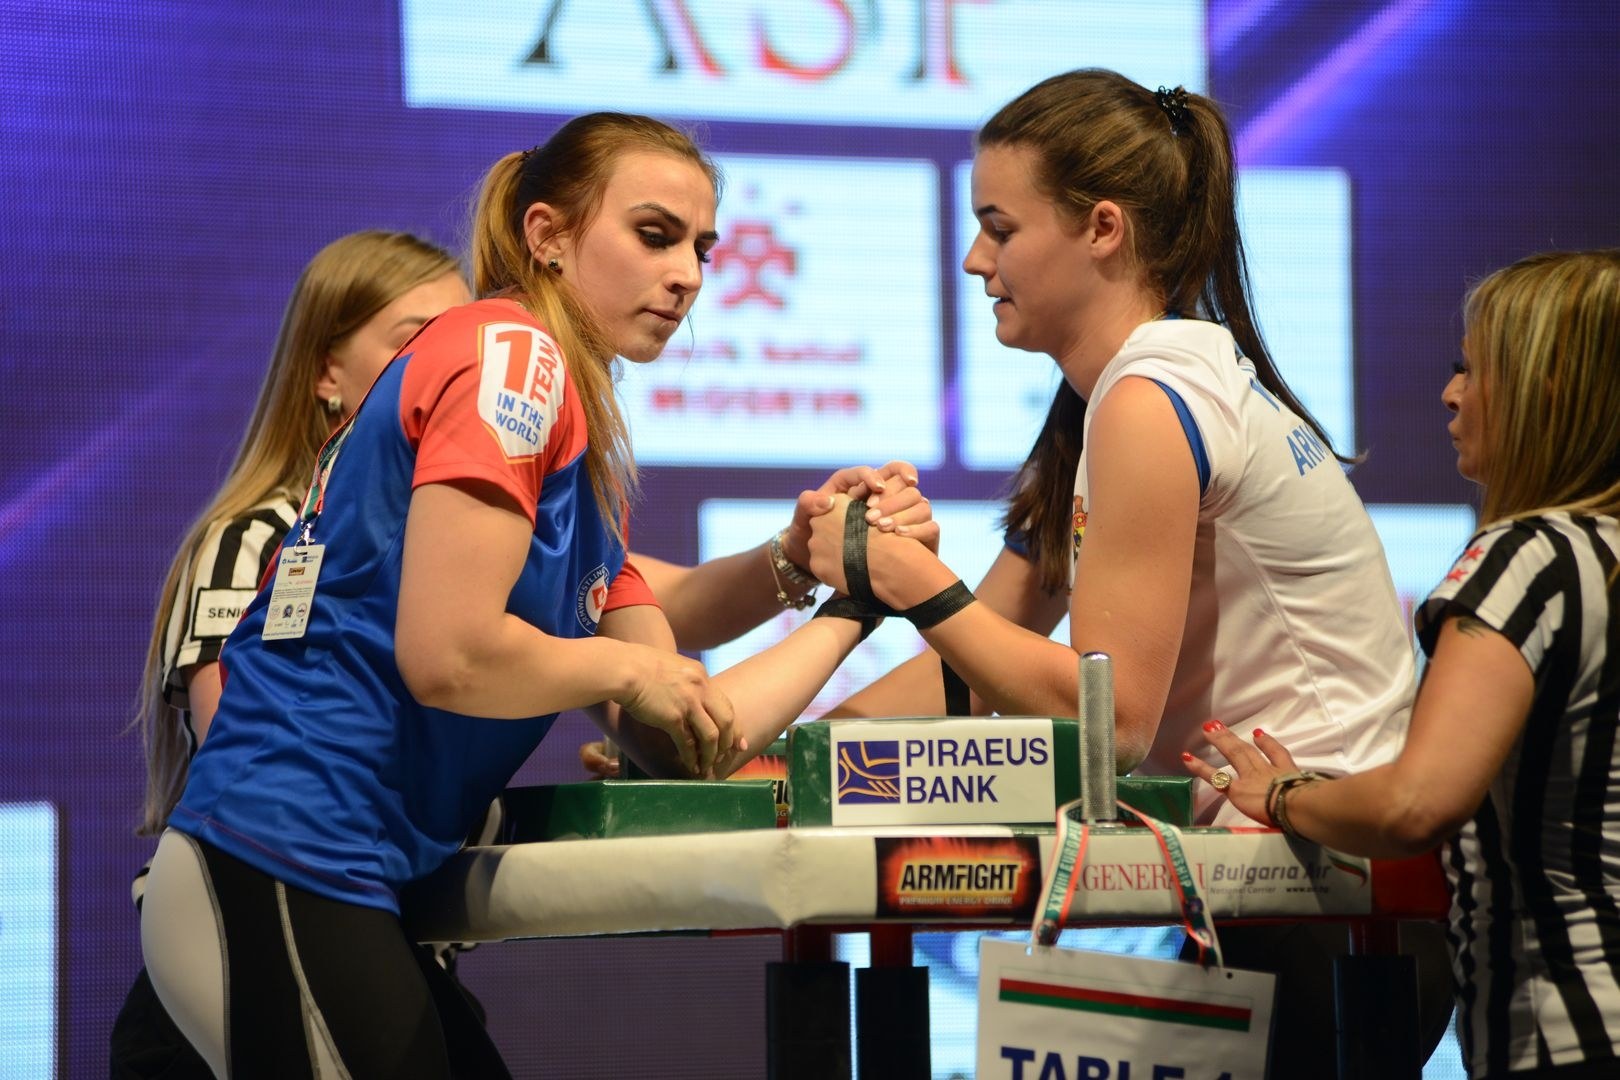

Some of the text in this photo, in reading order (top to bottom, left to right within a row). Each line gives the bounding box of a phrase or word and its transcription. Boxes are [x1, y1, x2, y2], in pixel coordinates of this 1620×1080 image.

[495, 329, 533, 395] 1
[528, 337, 558, 406] TEAM
[497, 392, 544, 431] IN THE
[495, 410, 539, 446] WORLD
[905, 737, 1049, 767] PIRAEUS
[905, 775, 999, 804] BANK
[901, 864, 1019, 891] ARMFIGHT
[1082, 862, 1207, 892] GENERI
[1212, 863, 1332, 885] Bulgaria Air
